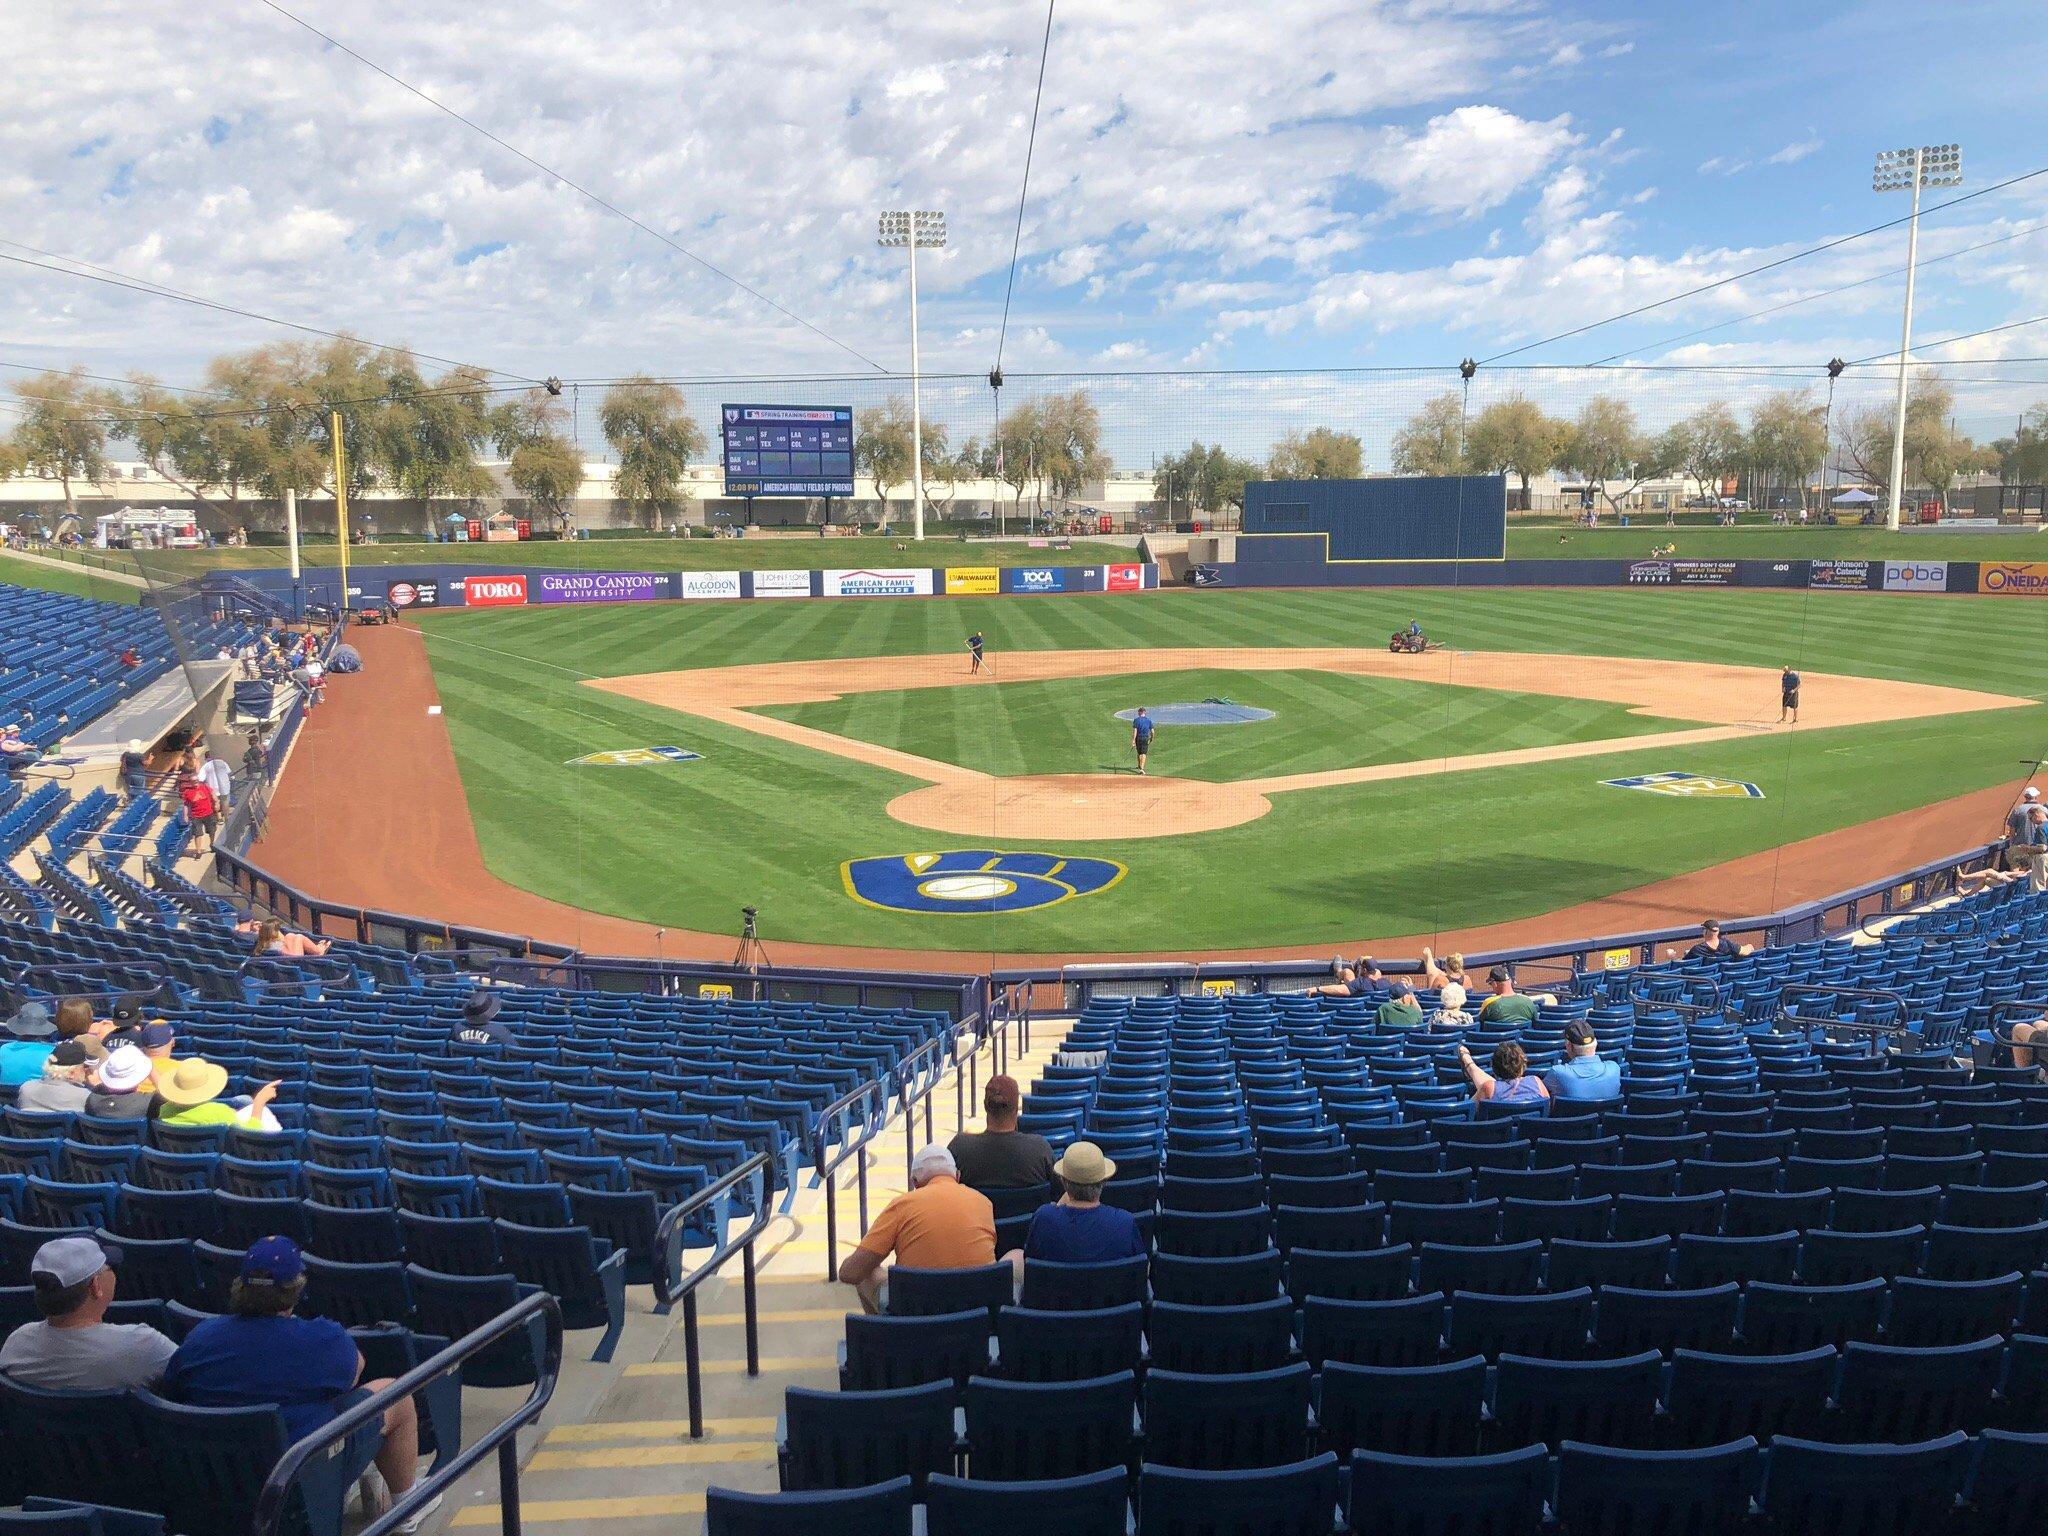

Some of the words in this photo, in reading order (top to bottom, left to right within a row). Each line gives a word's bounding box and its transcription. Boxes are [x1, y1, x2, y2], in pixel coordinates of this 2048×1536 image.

[764, 483, 789, 492] AMERICAN
[790, 483, 806, 492] FAMILY
[808, 483, 824, 492] FIELDS
[825, 483, 831, 491] OF
[832, 483, 852, 492] PHOENIX
[1834, 560, 1869, 568] Johnson's
[1023, 571, 1053, 582] TOCA
[1836, 568, 1867, 577] Catering
[542, 576, 594, 590] GRAND
[596, 576, 652, 588] CANYON
[654, 576, 668, 584] 374
[450, 582, 466, 590] 365
[688, 580, 736, 591] ALGODON
[347, 587, 361, 595] 350
[564, 588, 633, 598] UNIVERSITY
